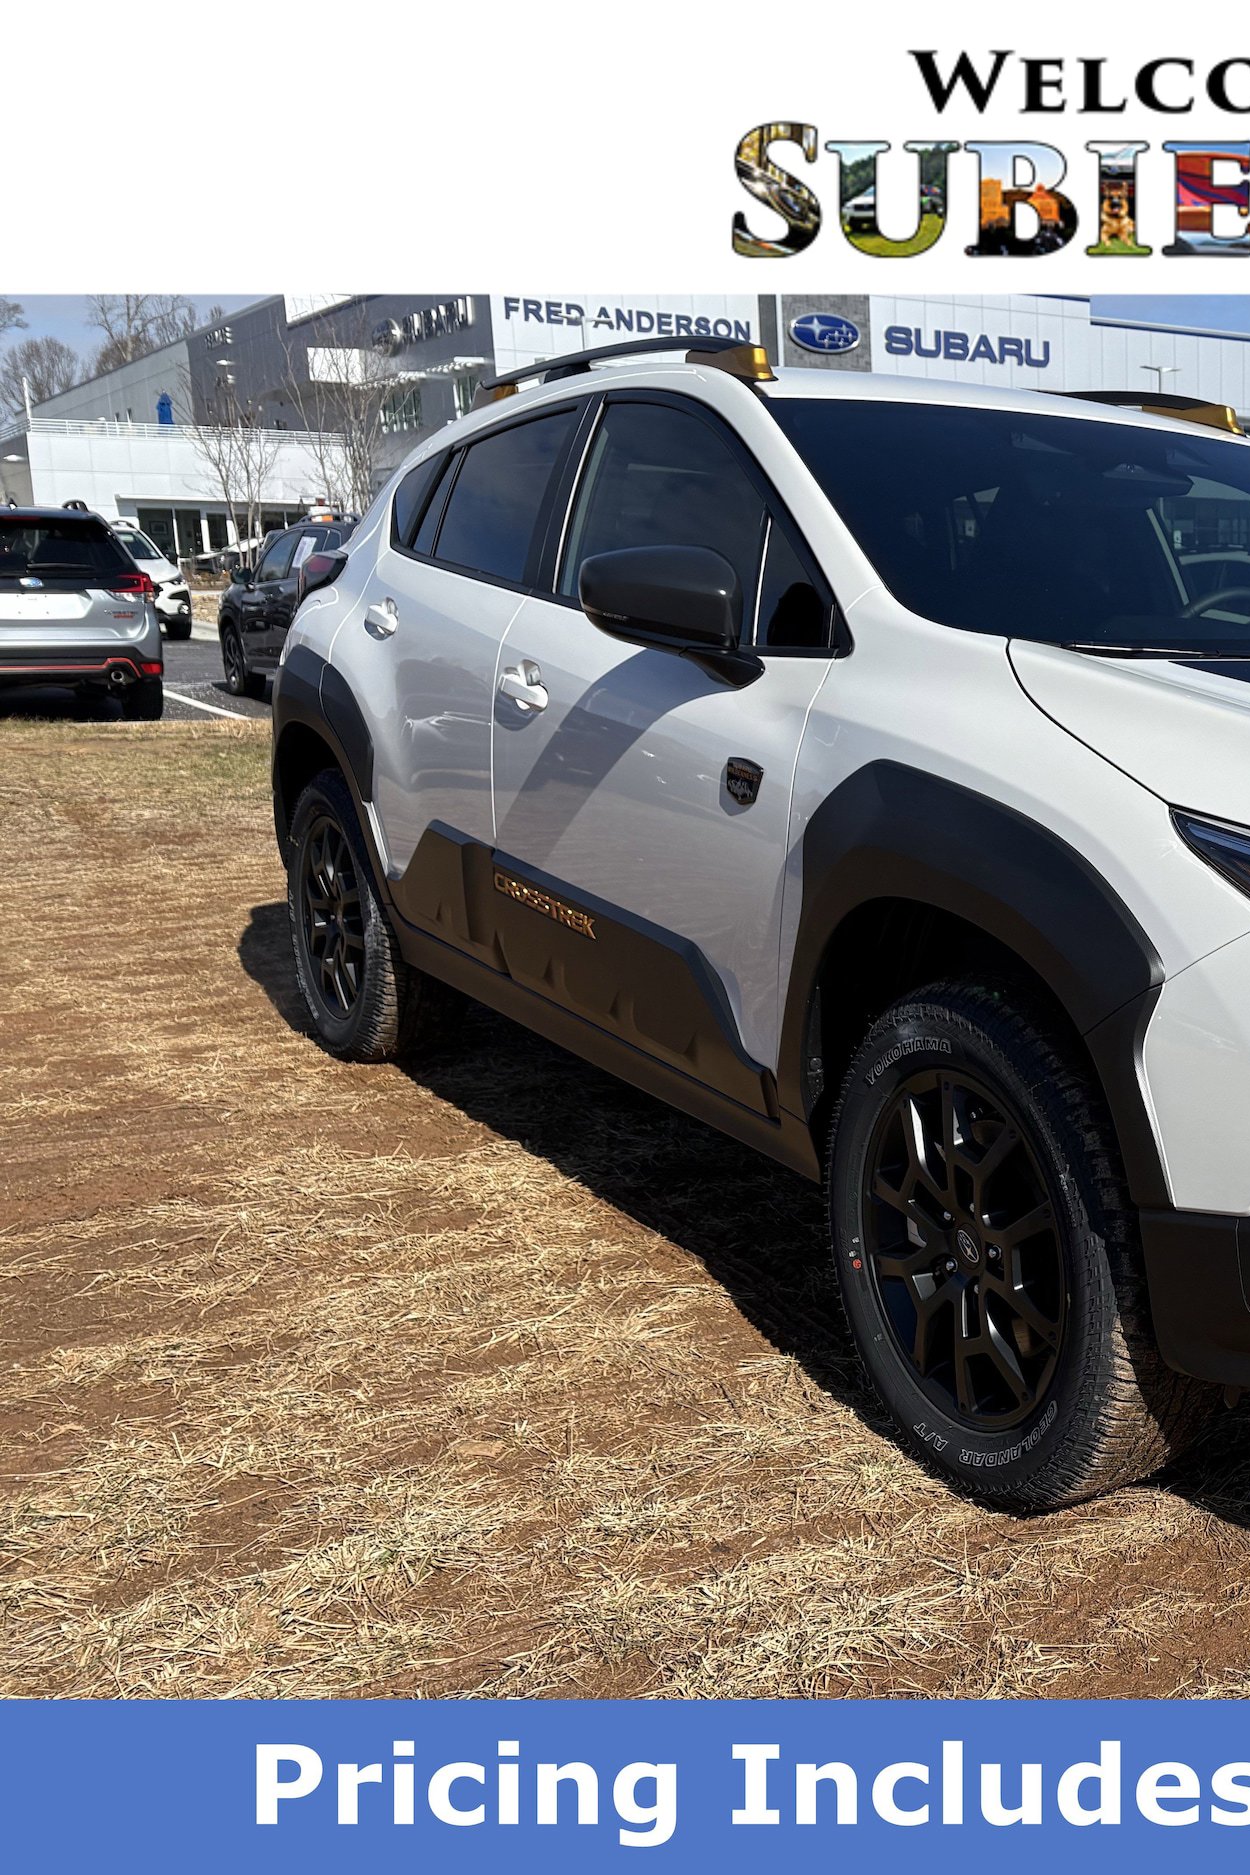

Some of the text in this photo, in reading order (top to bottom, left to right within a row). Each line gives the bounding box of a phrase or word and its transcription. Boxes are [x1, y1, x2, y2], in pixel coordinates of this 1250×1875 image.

[503, 297, 751, 342] FRED ANDERSON
[884, 325, 1050, 368] SUBARU
[494, 872, 596, 940] CROSSTREK
[865, 1036, 951, 1084] YOKOHAMA
[913, 1399, 1058, 1467] GEOLANDAR A/T
